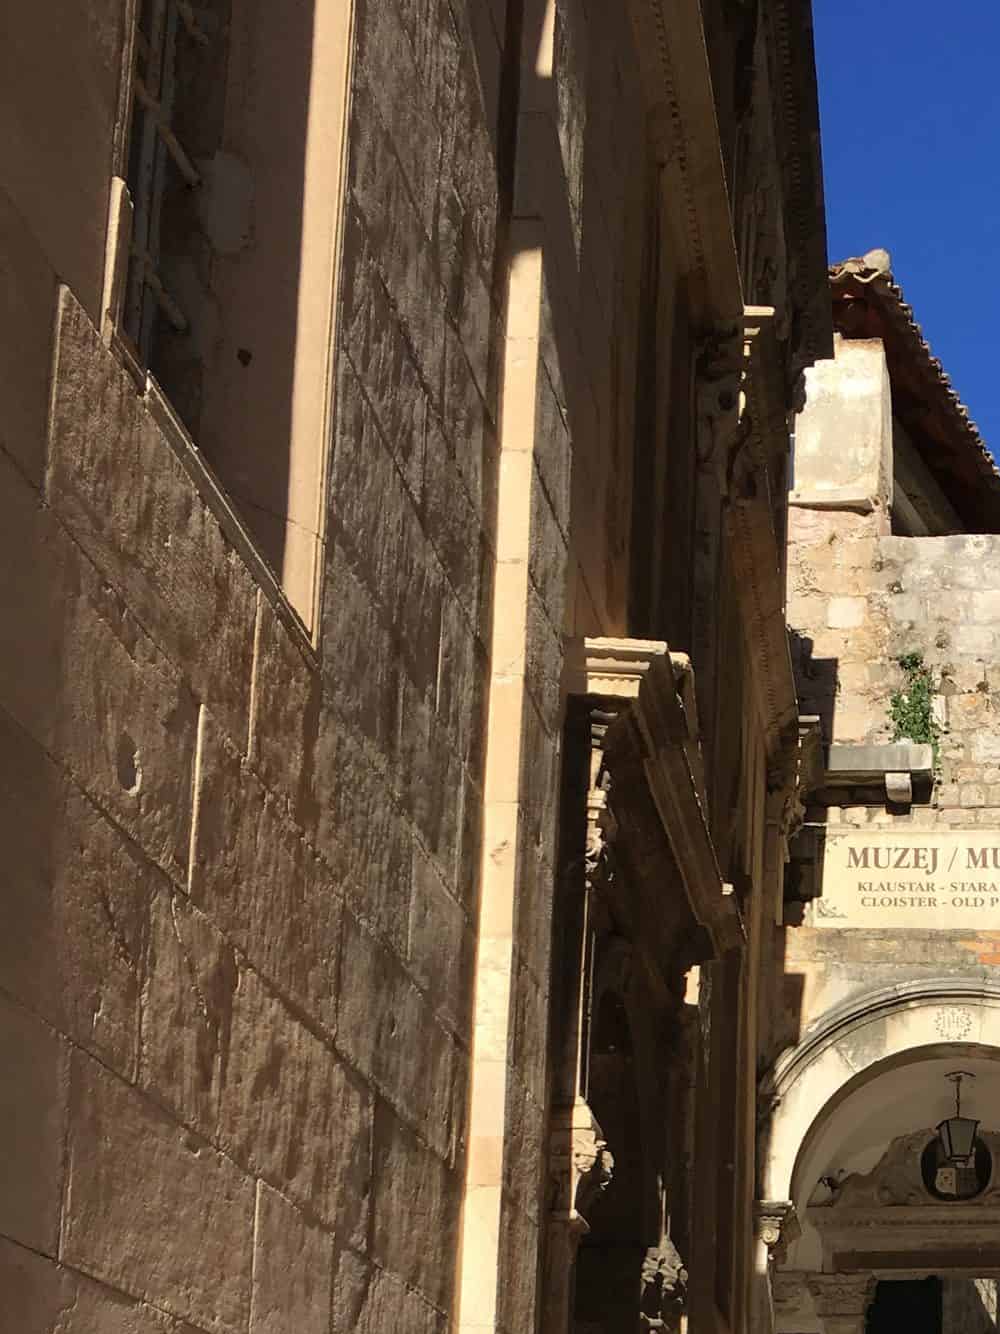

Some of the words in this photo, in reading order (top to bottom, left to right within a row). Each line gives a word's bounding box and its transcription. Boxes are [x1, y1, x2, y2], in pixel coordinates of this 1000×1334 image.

[847, 847, 938, 875] MUZEJ
[948, 847, 959, 872] /
[857, 881, 936, 892] KLAUSTAR
[950, 881, 997, 892] STARA
[860, 896, 937, 907] CLOISTER
[951, 896, 986, 908] OLD
